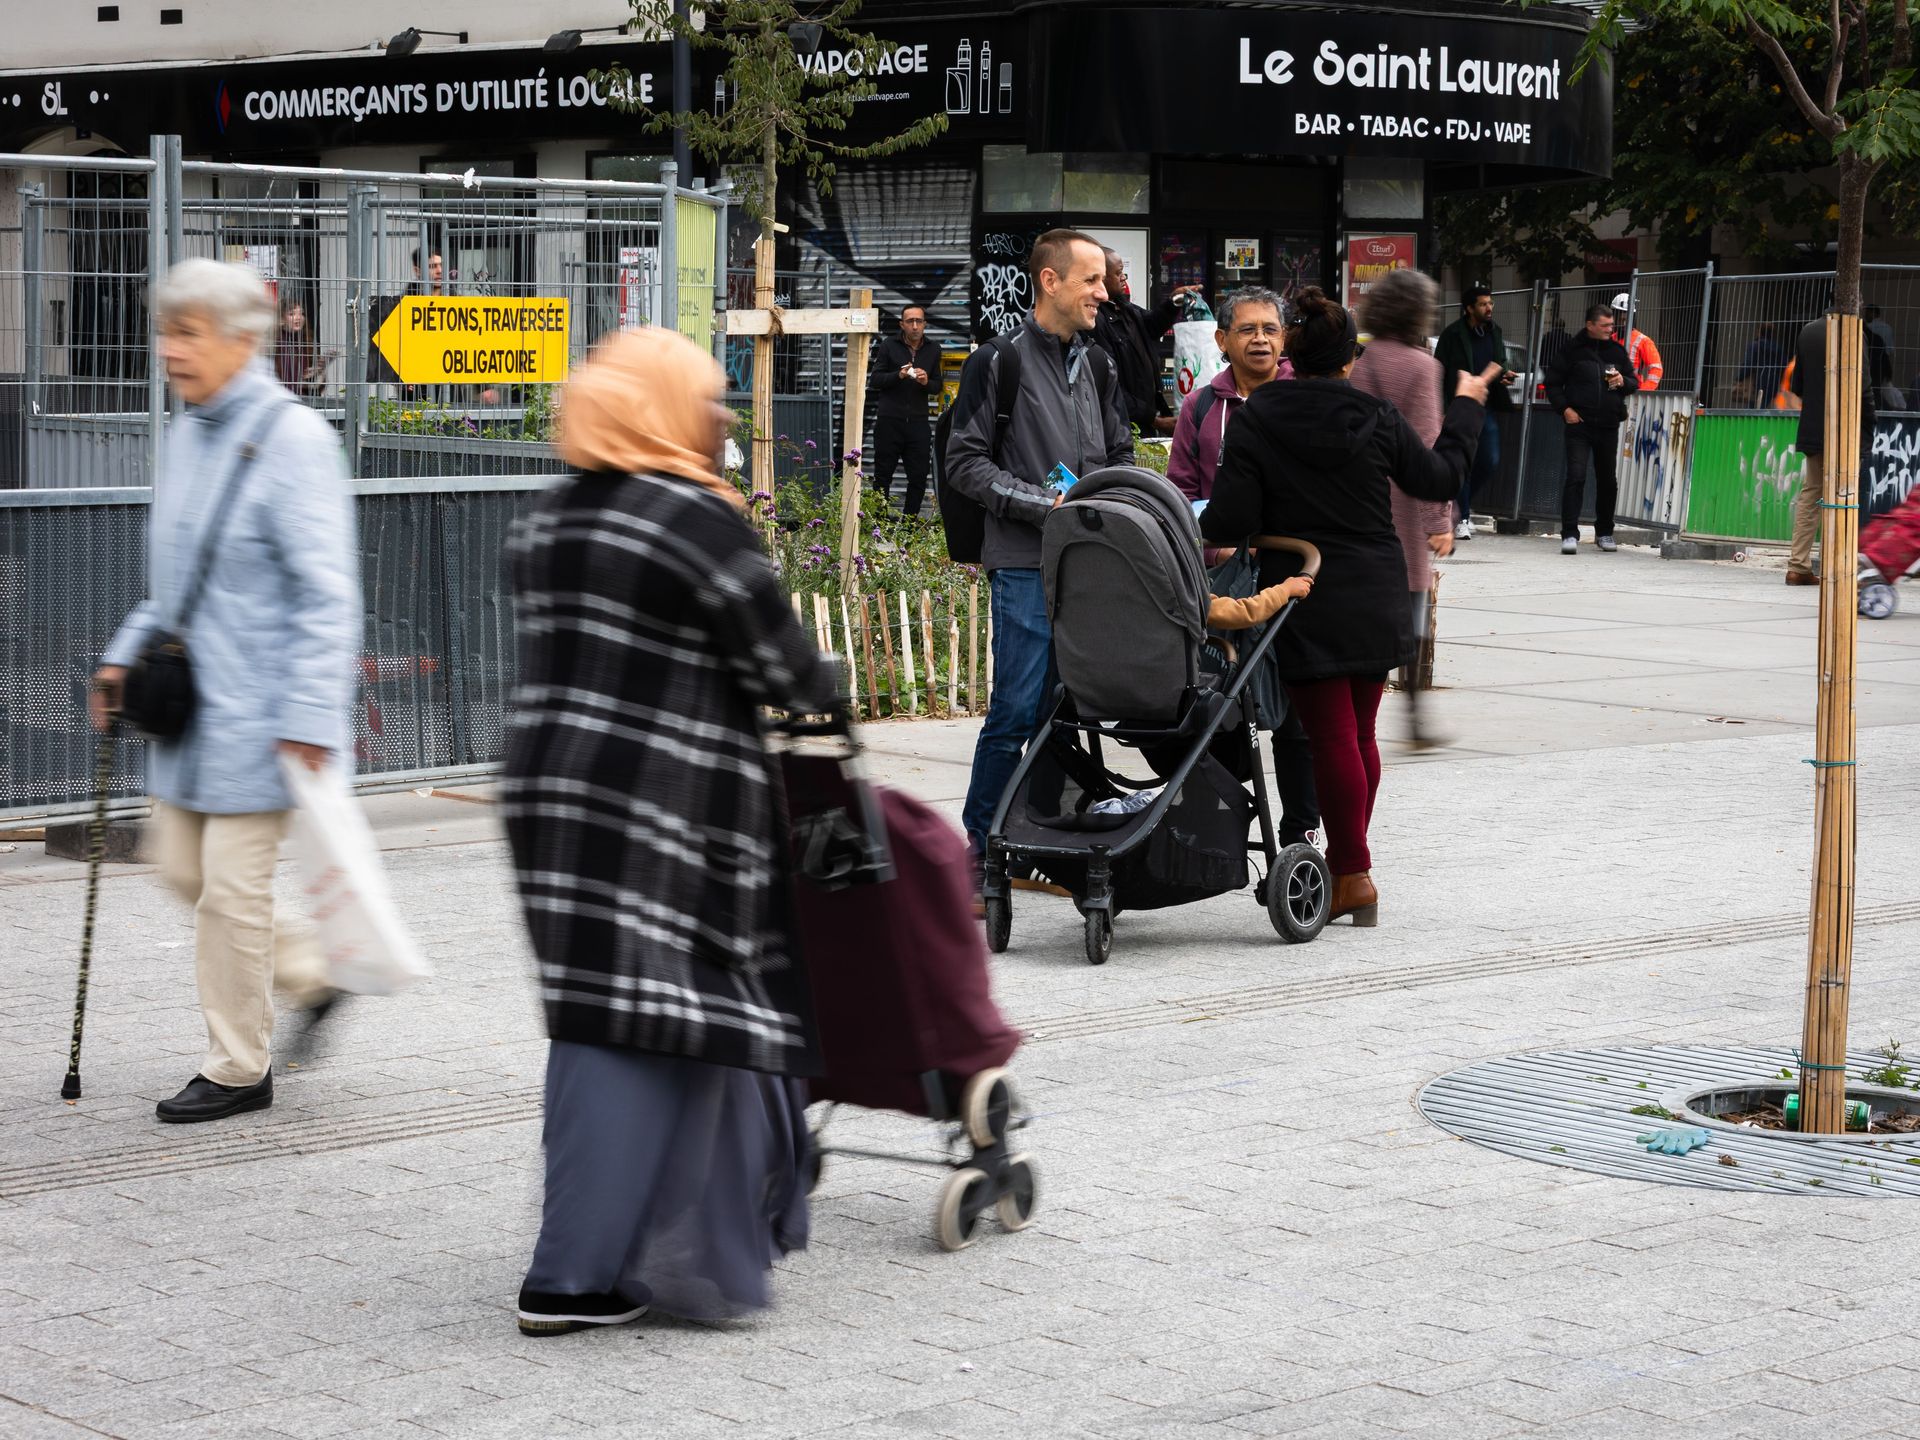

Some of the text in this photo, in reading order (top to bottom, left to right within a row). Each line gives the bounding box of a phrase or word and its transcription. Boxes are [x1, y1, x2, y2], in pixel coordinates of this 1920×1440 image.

[1239, 37, 1562, 101] Le Saint Laurent
[244, 83, 428, 122] COMMERÇANTS
[436, 67, 549, 112] D'UTILITÉ
[1295, 113, 1531, 144] BAR TABAC FDJ VAPE
[1371, 244, 1391, 253] ZEturf
[411, 302, 564, 336] PIÉTONS, TRAVERSÉE
[442, 349, 537, 374] OBLIGATOIRE
